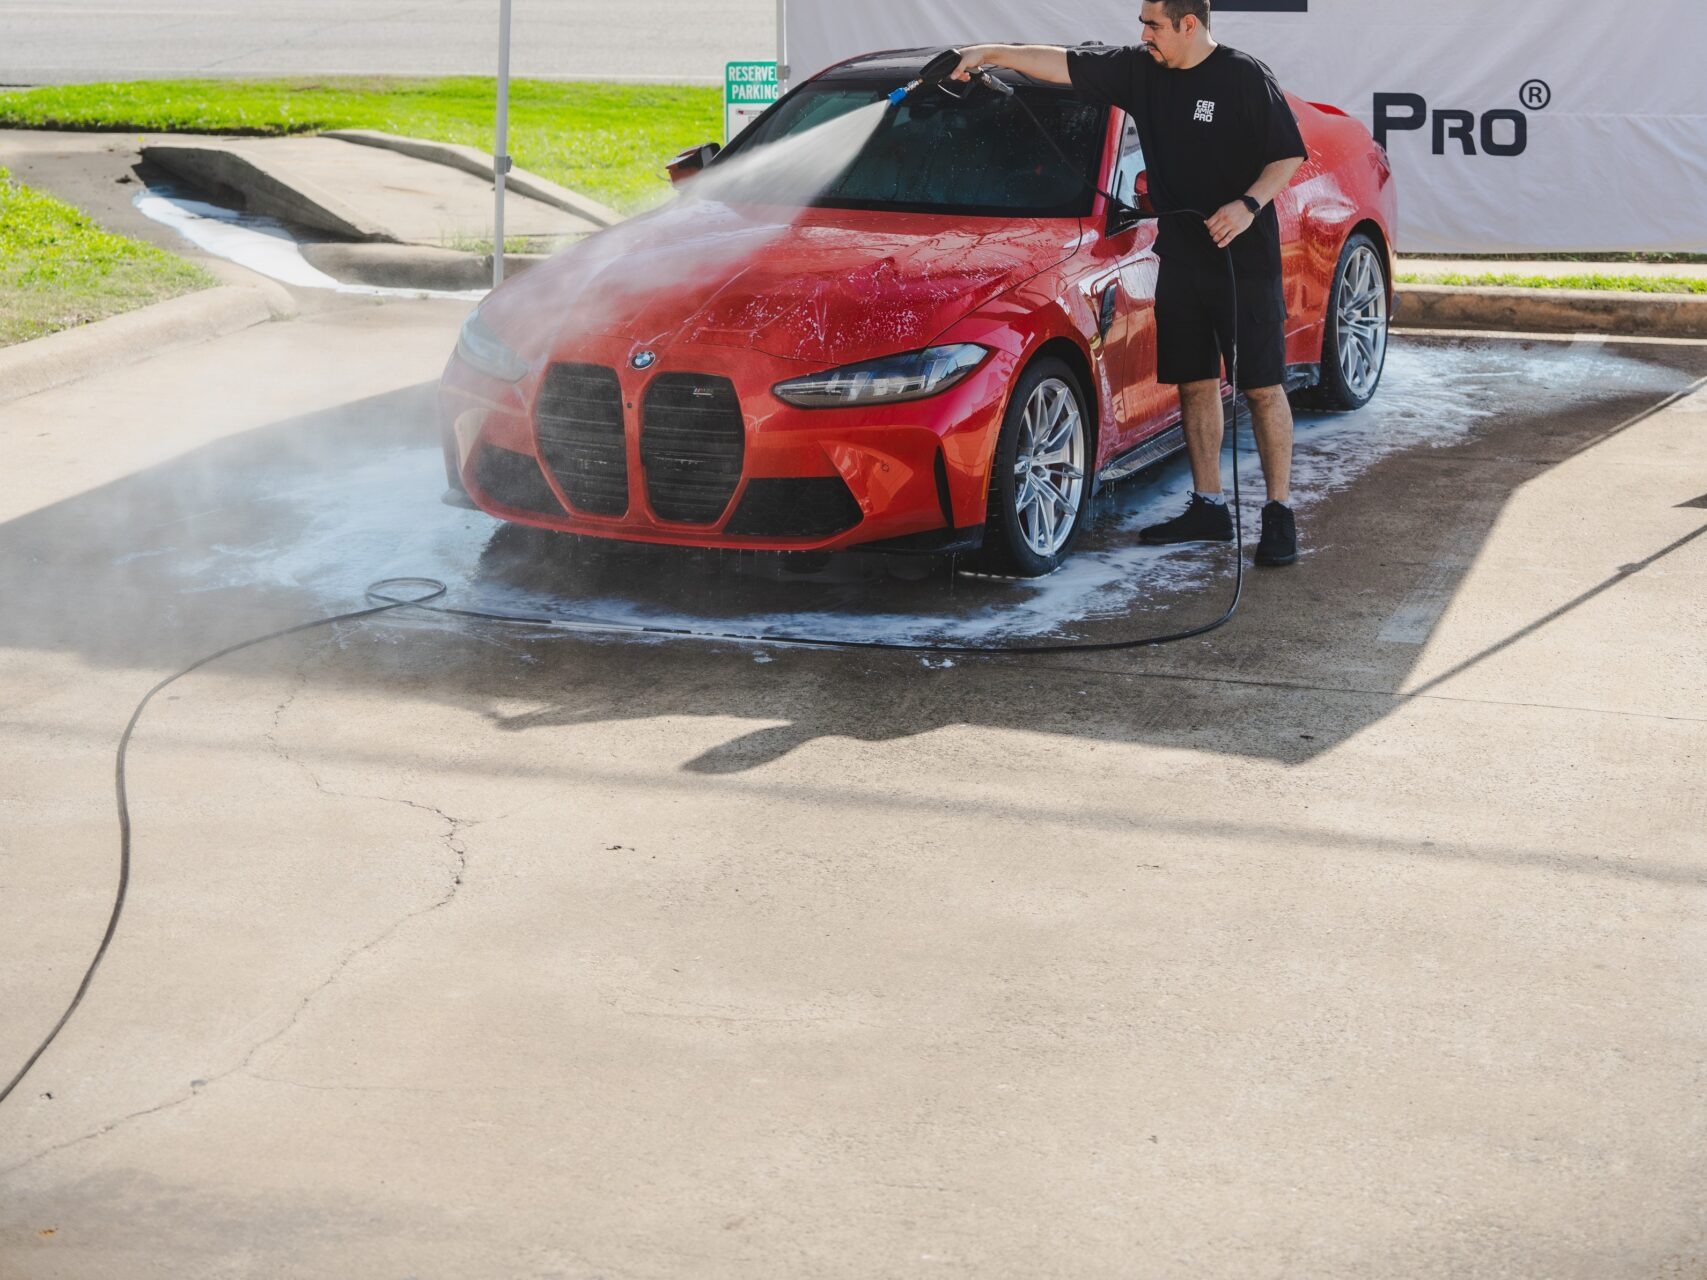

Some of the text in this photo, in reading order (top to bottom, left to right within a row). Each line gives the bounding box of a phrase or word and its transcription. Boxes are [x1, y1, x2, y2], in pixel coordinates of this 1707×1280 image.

[728, 66, 778, 81] RESERVE
[1196, 99, 1215, 111] CER
[1193, 112, 1213, 123] PRO
